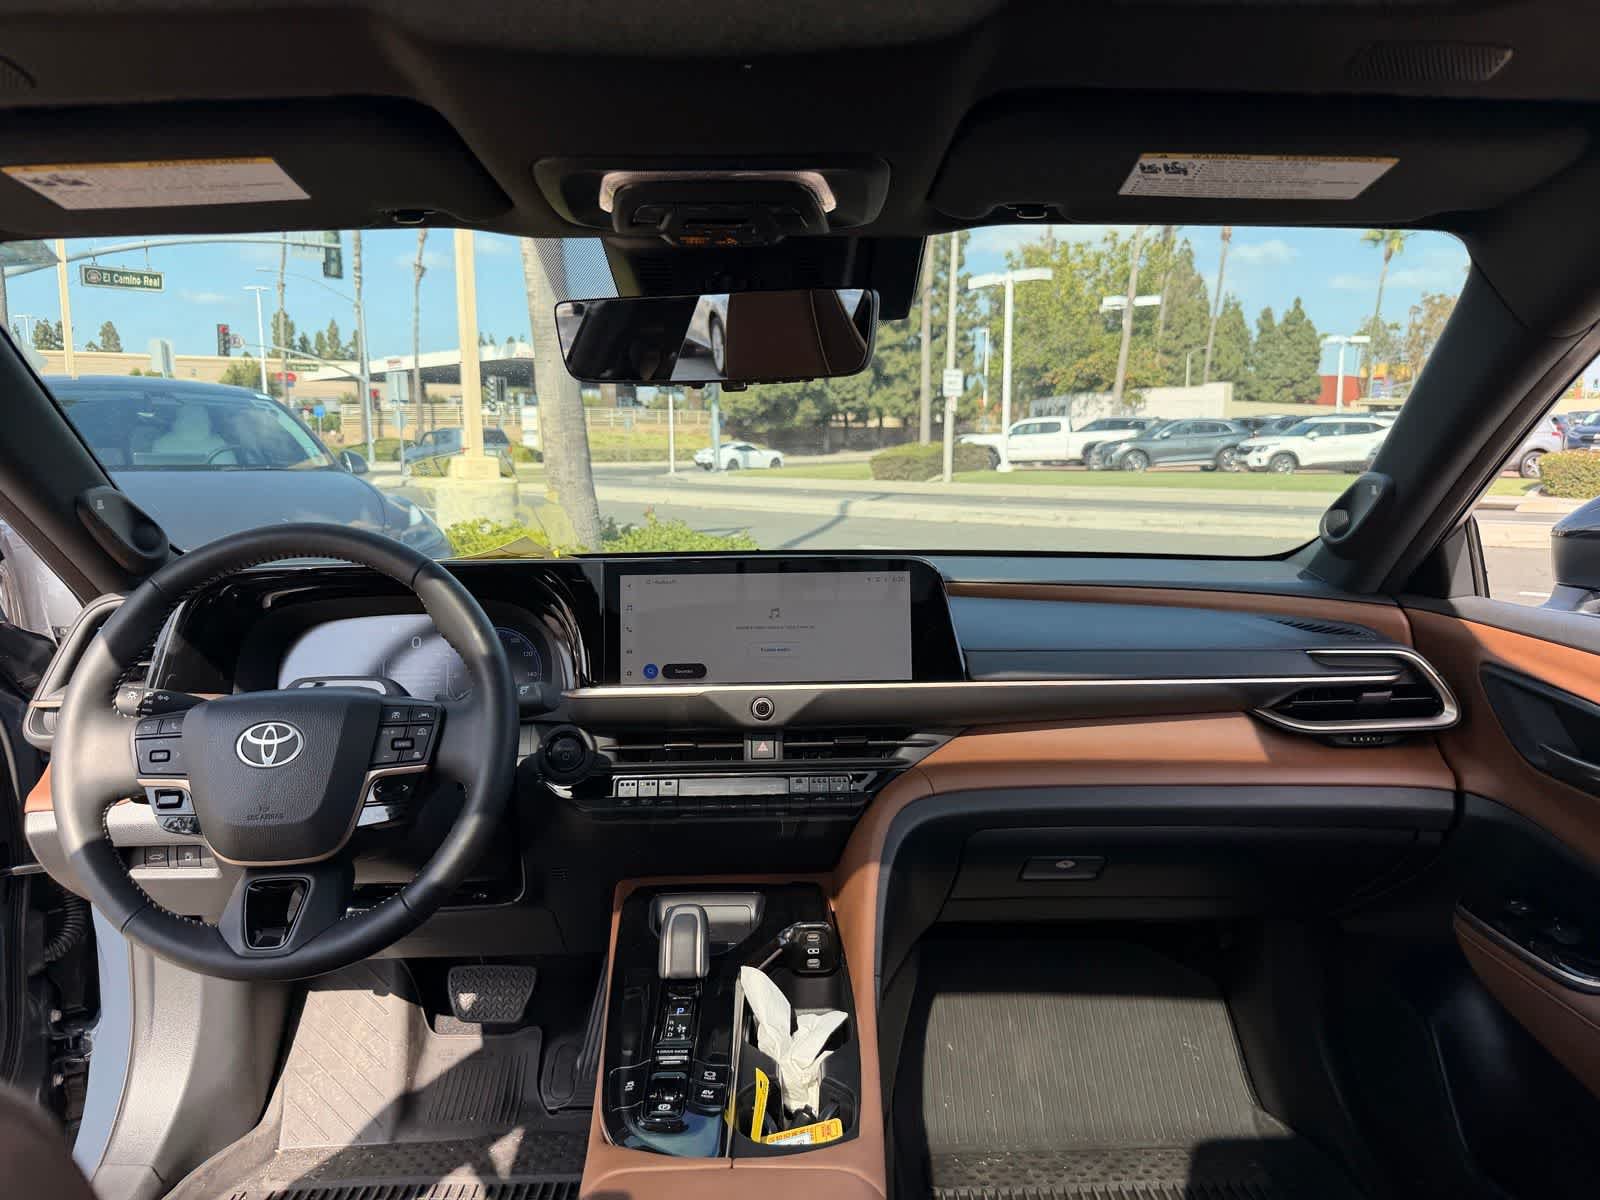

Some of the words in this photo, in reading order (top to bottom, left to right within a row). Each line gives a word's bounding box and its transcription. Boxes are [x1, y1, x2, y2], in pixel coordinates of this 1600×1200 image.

[102, 272, 111, 283] El
[113, 274, 141, 285] Camino
[143, 276, 160, 287] Real
[411, 636, 422, 649] 0
[676, 1007, 685, 1015] P
